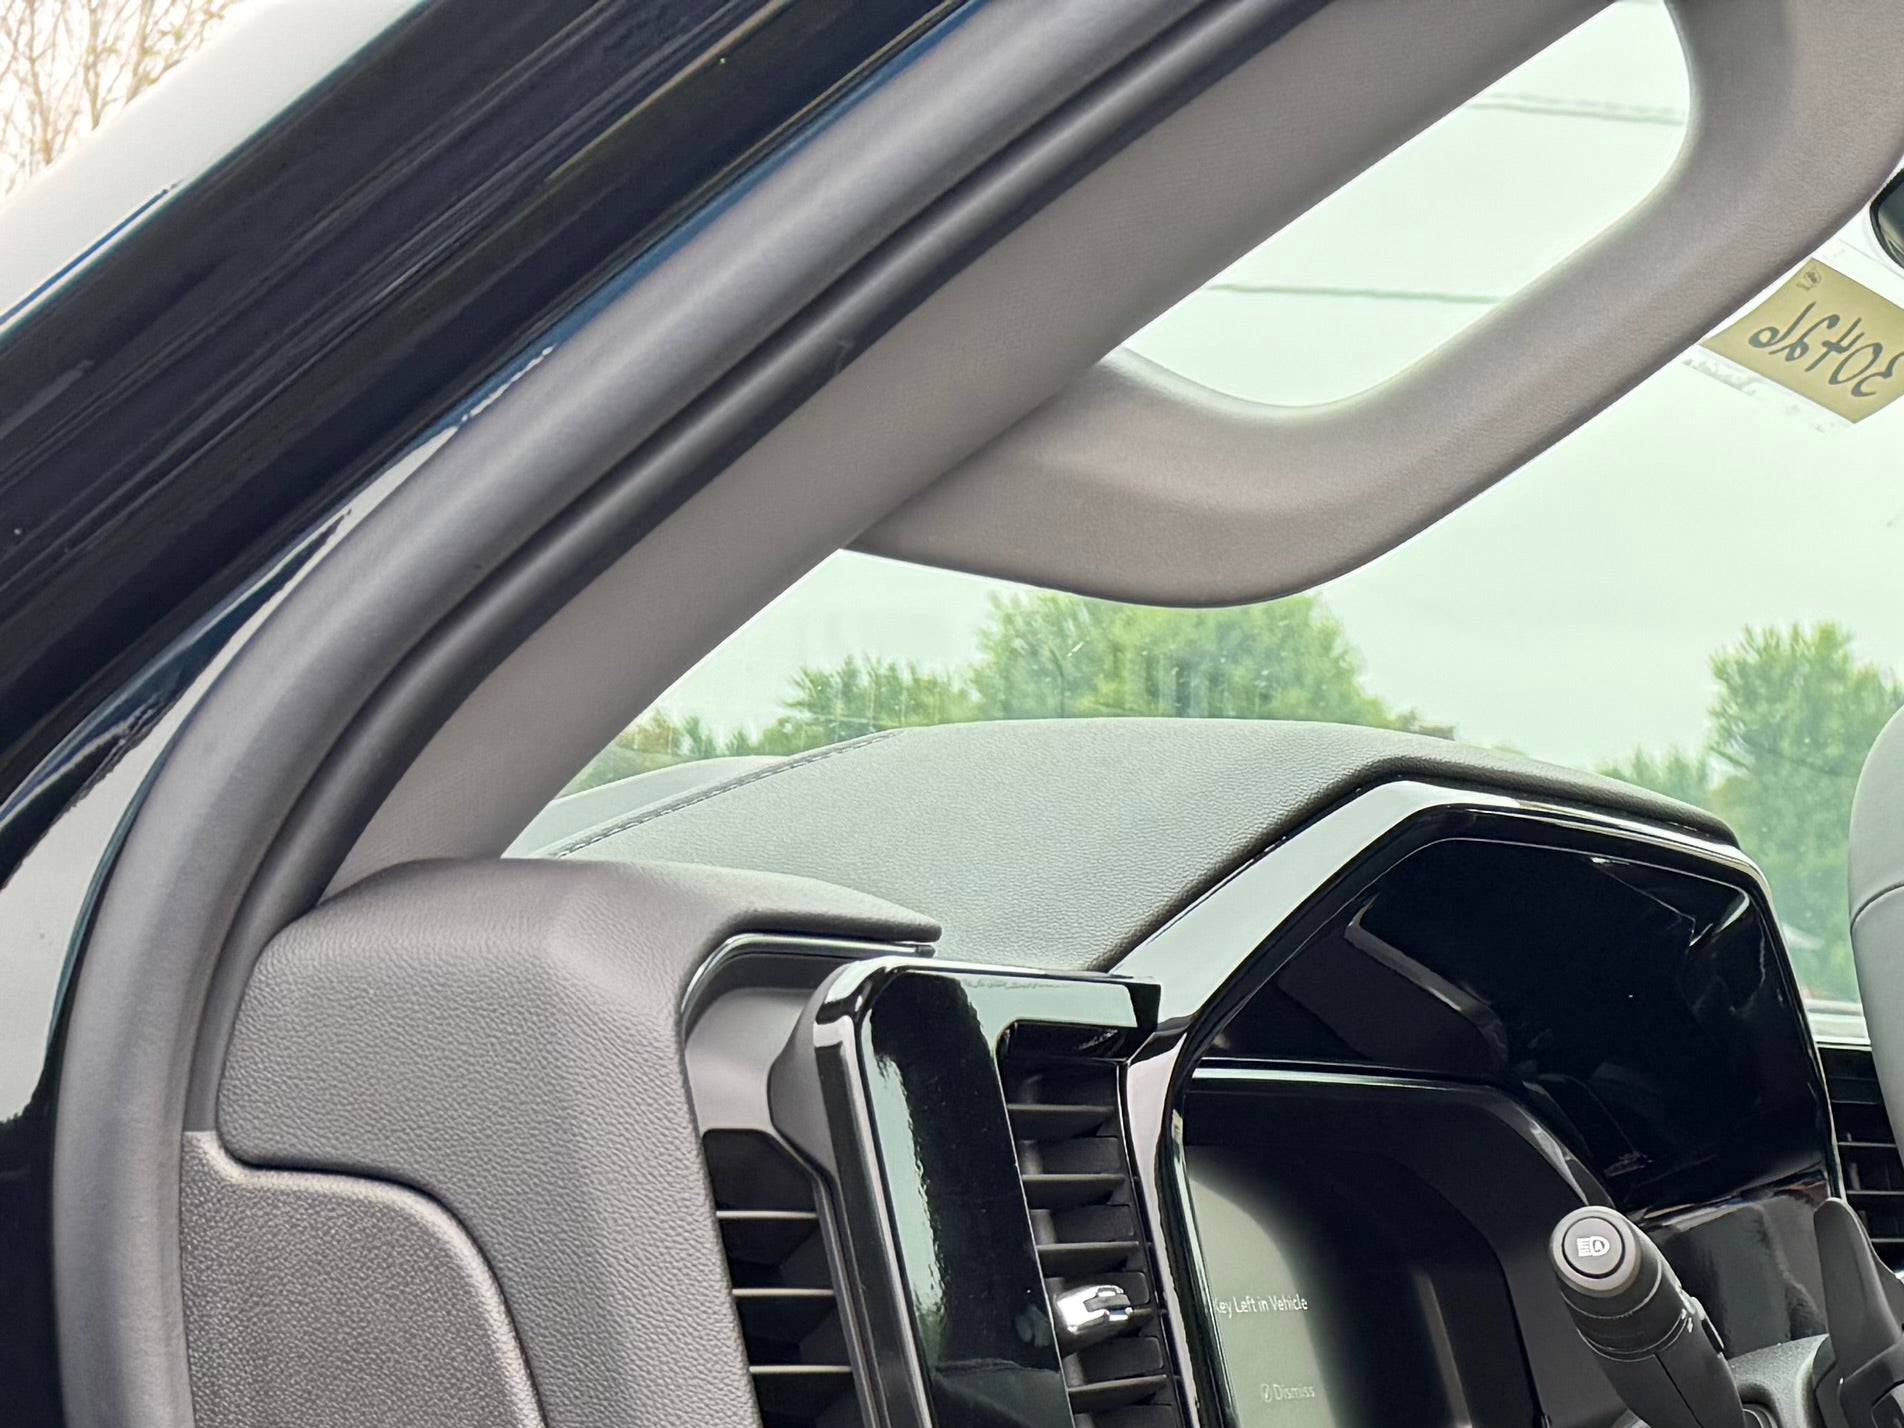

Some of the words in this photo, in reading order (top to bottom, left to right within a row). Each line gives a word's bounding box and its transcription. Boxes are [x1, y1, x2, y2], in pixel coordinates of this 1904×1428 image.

[1233, 1295, 1257, 1313] Left
[1257, 1296, 1270, 1312] in
[1269, 1293, 1309, 1311] Vehicle
[1273, 1384, 1316, 1400] Dismiss
